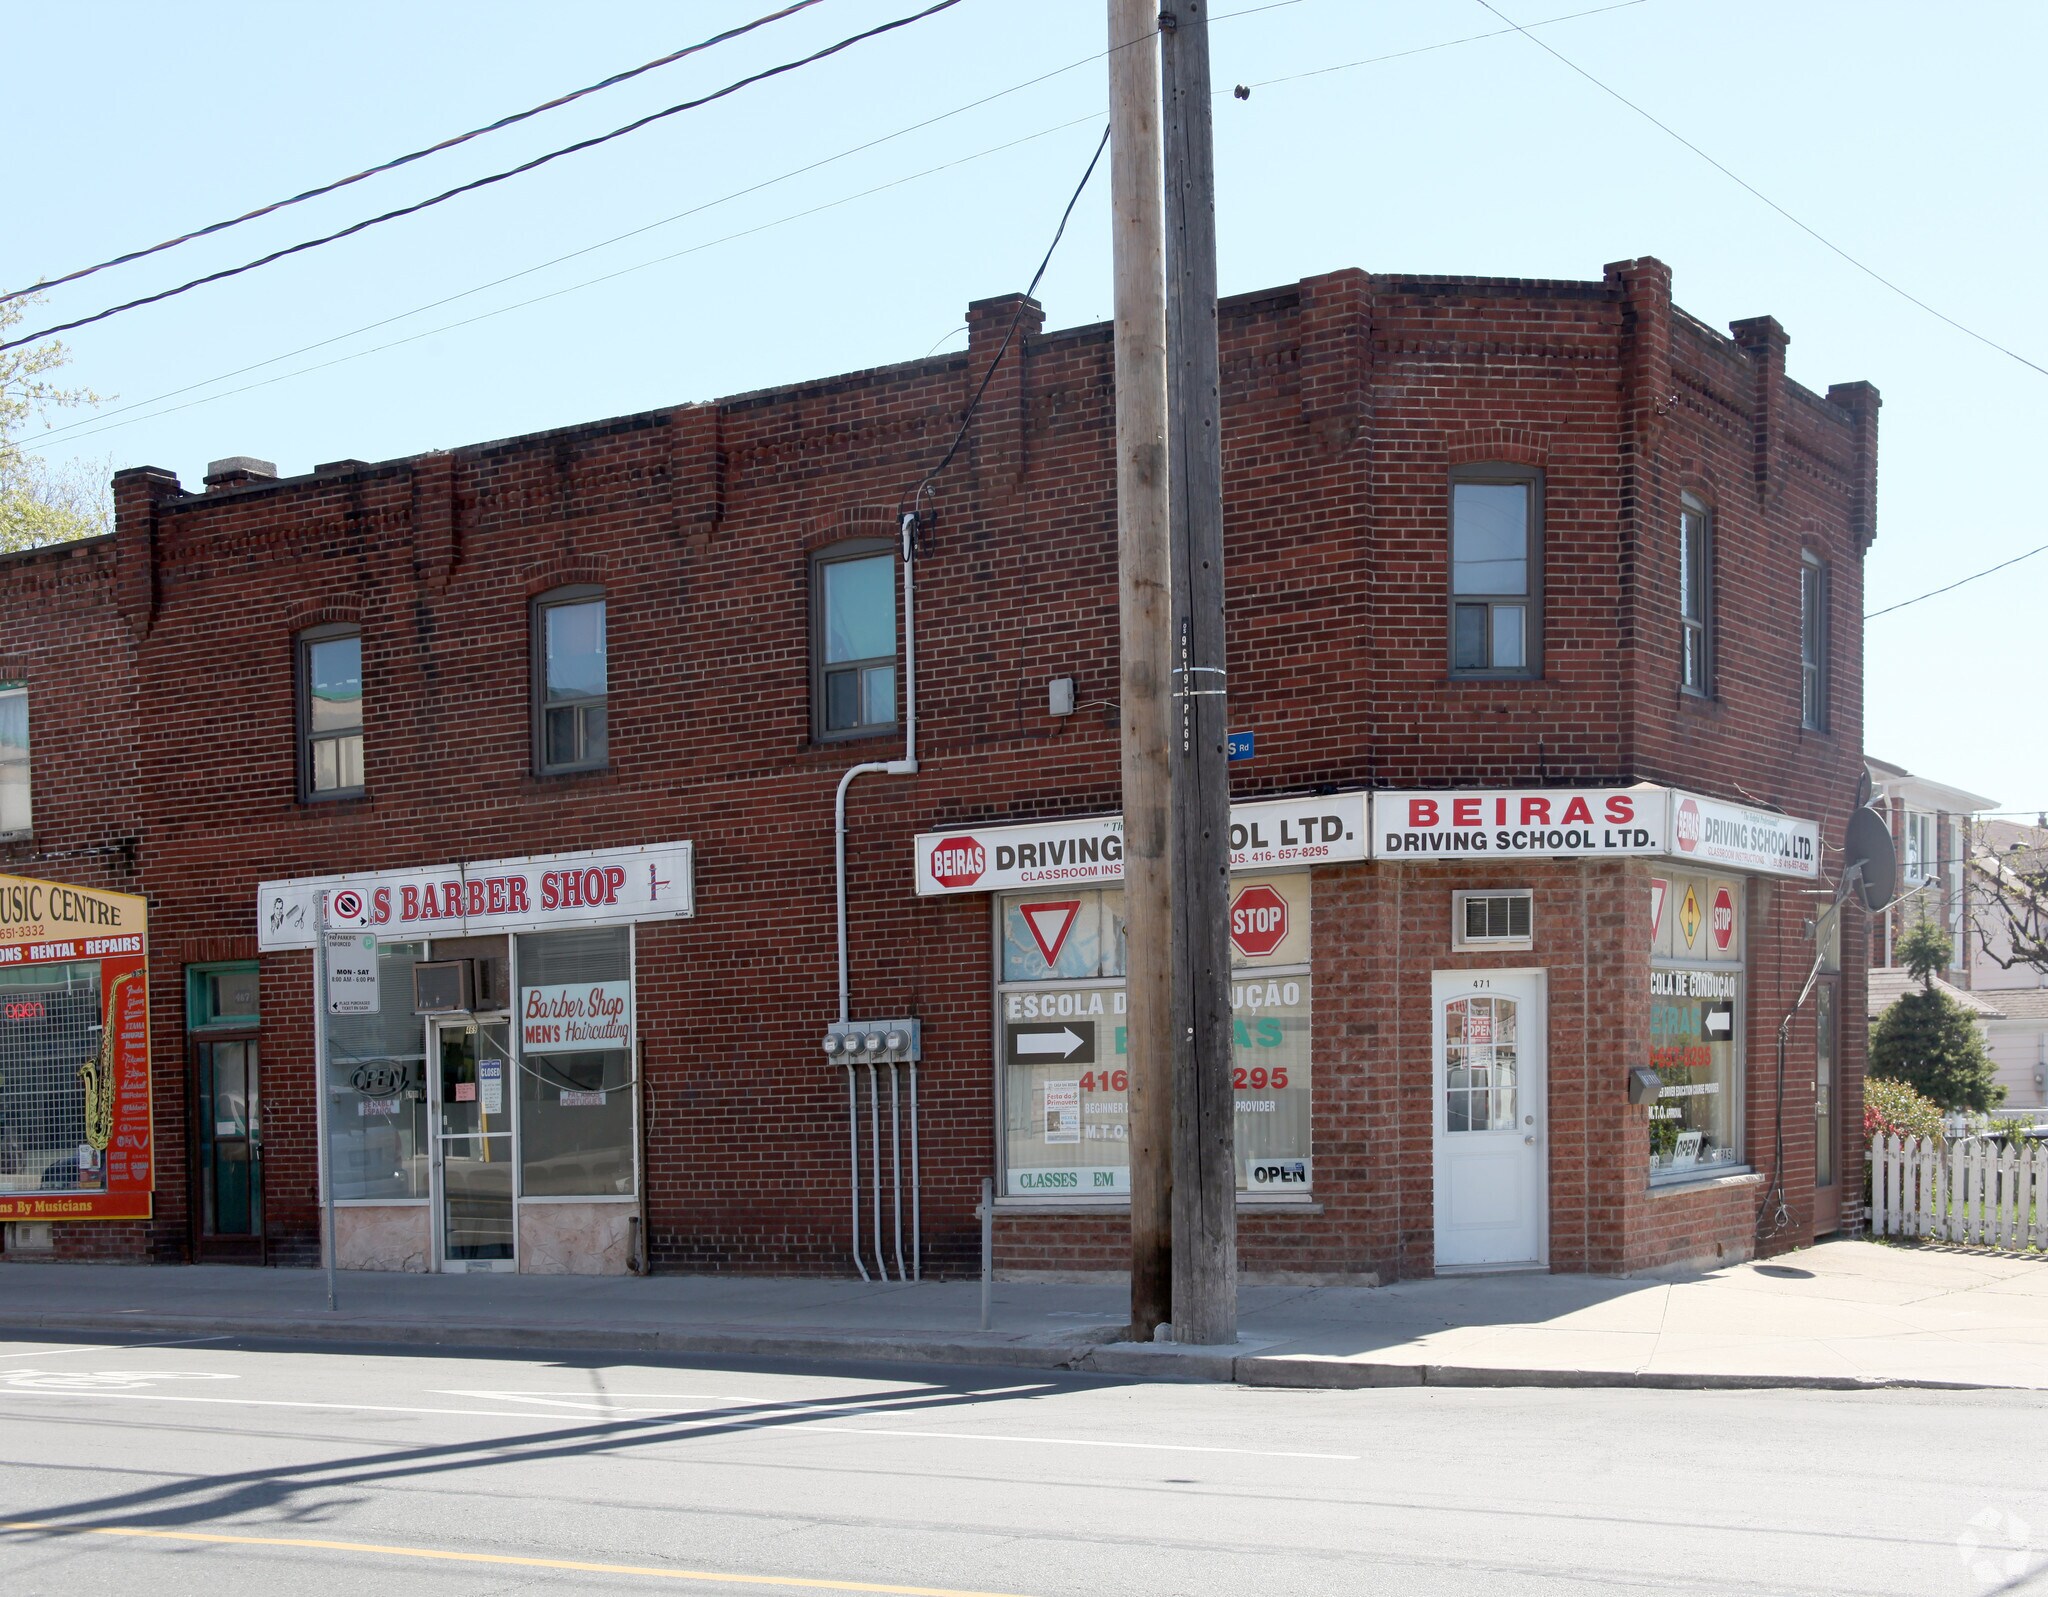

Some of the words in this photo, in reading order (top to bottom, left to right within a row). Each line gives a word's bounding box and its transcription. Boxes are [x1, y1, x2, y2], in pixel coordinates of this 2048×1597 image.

[1228, 742, 1236, 755] S
[1239, 743, 1249, 752] Rd
[1408, 795, 1635, 828] BEIRAS
[1280, 815, 1353, 846] LTD.
[1678, 810, 1699, 841] BEIRAS
[1386, 831, 1487, 852] DRIVING
[1495, 829, 1596, 849] SCHOOL
[1604, 828, 1656, 848] LTD.
[1705, 817, 1748, 850] DRIVING
[1751, 826, 1789, 857] SCHOOL
[1793, 835, 1813, 861] LTD.
[934, 847, 984, 877] BEIRAS
[996, 835, 1123, 871] DRIVING
[1230, 853, 1248, 864] US.
[1708, 846, 1734, 859] CLASSROOM
[1735, 851, 1765, 865] INSTRUCTIONS
[1021, 867, 1098, 882] CLASSROOM
[400, 876, 530, 921] BARBER
[541, 866, 626, 910] SHOP
[0, 886, 42, 923] USIC
[50, 887, 121, 926] CENTRE
[1233, 906, 1281, 936] STOP
[1715, 907, 1731, 930] STOP
[0, 947, 22, 961] ONS
[31, 942, 76, 960] RENTAL
[86, 936, 140, 955] REPAIRS
[1473, 980, 1490, 988] 471
[1650, 972, 1673, 995] COLA
[1676, 973, 1687, 996] DE
[526, 990, 585, 1019] Barber
[588, 987, 624, 1025] Shop
[1008, 992, 1104, 1019] ESCOLA
[1114, 992, 1127, 1014] D
[1232, 980, 1300, 1016] UÇÃO
[525, 1025, 560, 1044] MEN'S
[565, 1019, 629, 1046] Haircutting
[1651, 1007, 1701, 1036] EIRAS
[352, 1066, 405, 1089] OPEN
[481, 1068, 500, 1077] CLOSED
[1079, 1069, 1128, 1092] 416
[1233, 1067, 1289, 1089] 295
[1085, 1103, 1124, 1114] BEGINNER
[1235, 1100, 1276, 1112] PROVIDER
[1676, 1139, 1699, 1158] OPEN
[1020, 1171, 1078, 1189] CLASSES
[1093, 1171, 1114, 1187] EM
[1254, 1165, 1306, 1183] OPEN
[17, 1201, 32, 1215] By
[35, 1200, 93, 1213] Musicians
